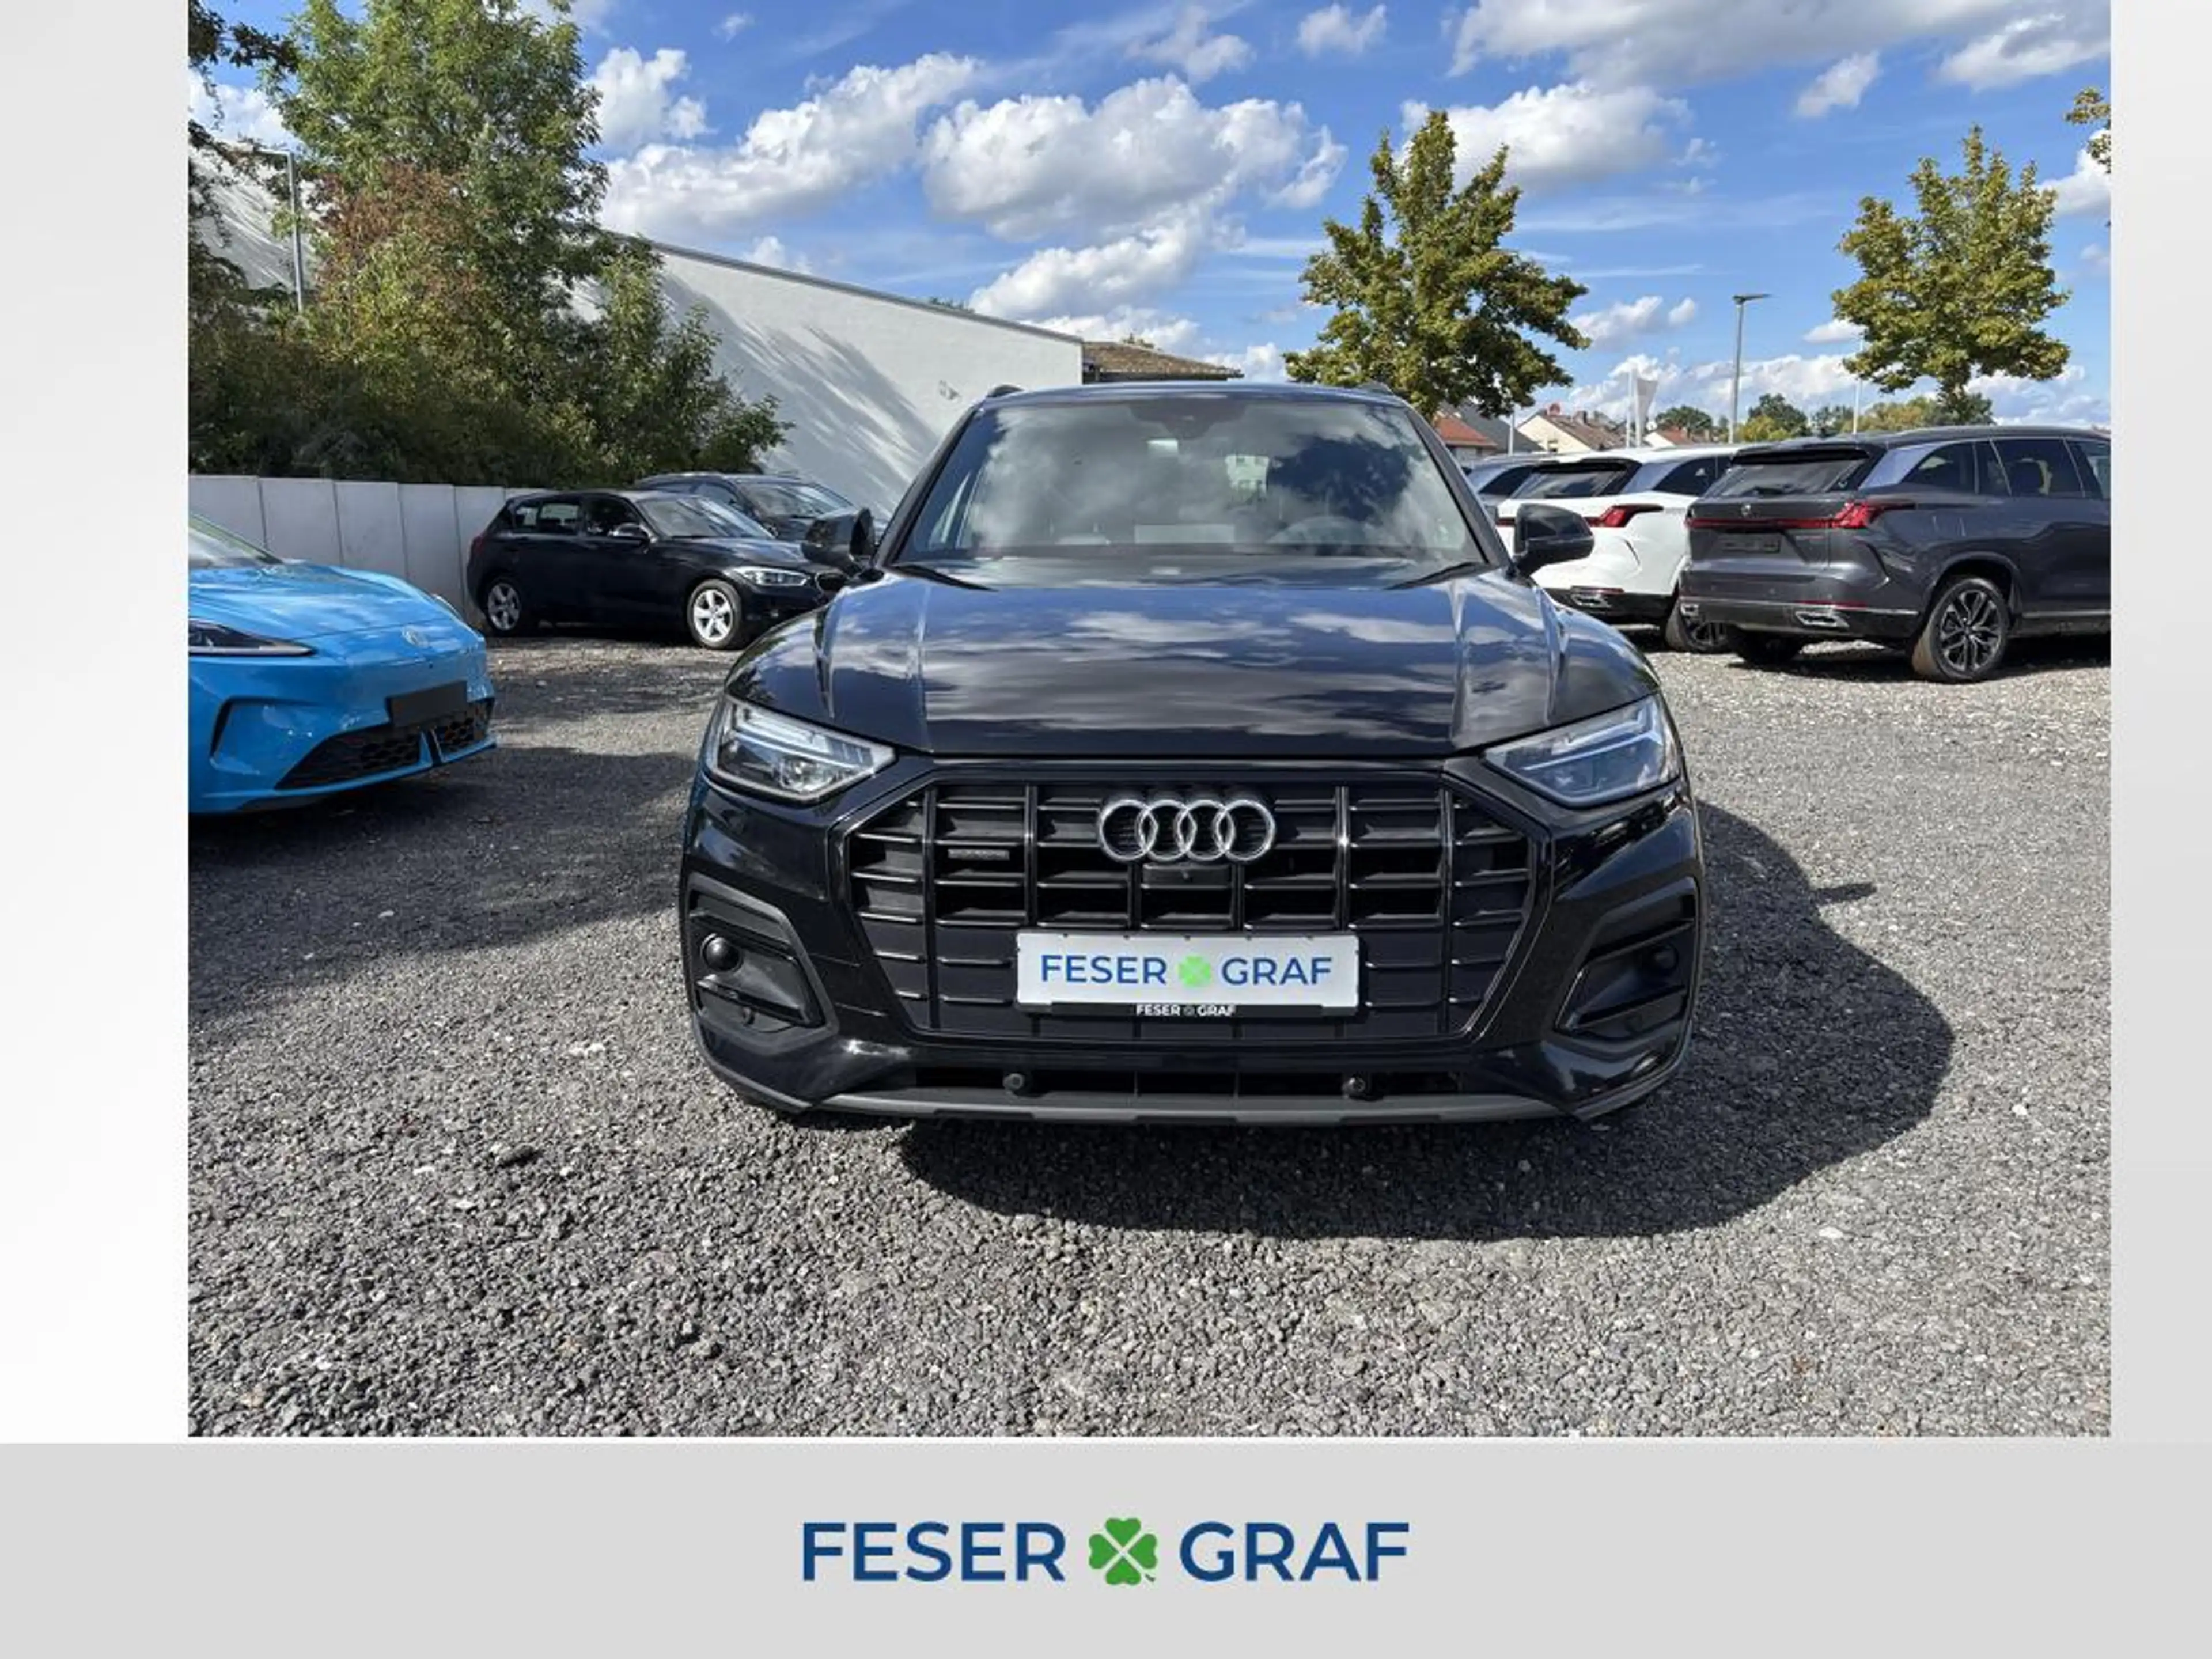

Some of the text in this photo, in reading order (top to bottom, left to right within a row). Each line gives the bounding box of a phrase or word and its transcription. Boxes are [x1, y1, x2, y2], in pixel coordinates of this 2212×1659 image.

[1041, 955, 1332, 986] FESER GRAF
[1136, 1004, 1236, 1017] FESER GRAF
